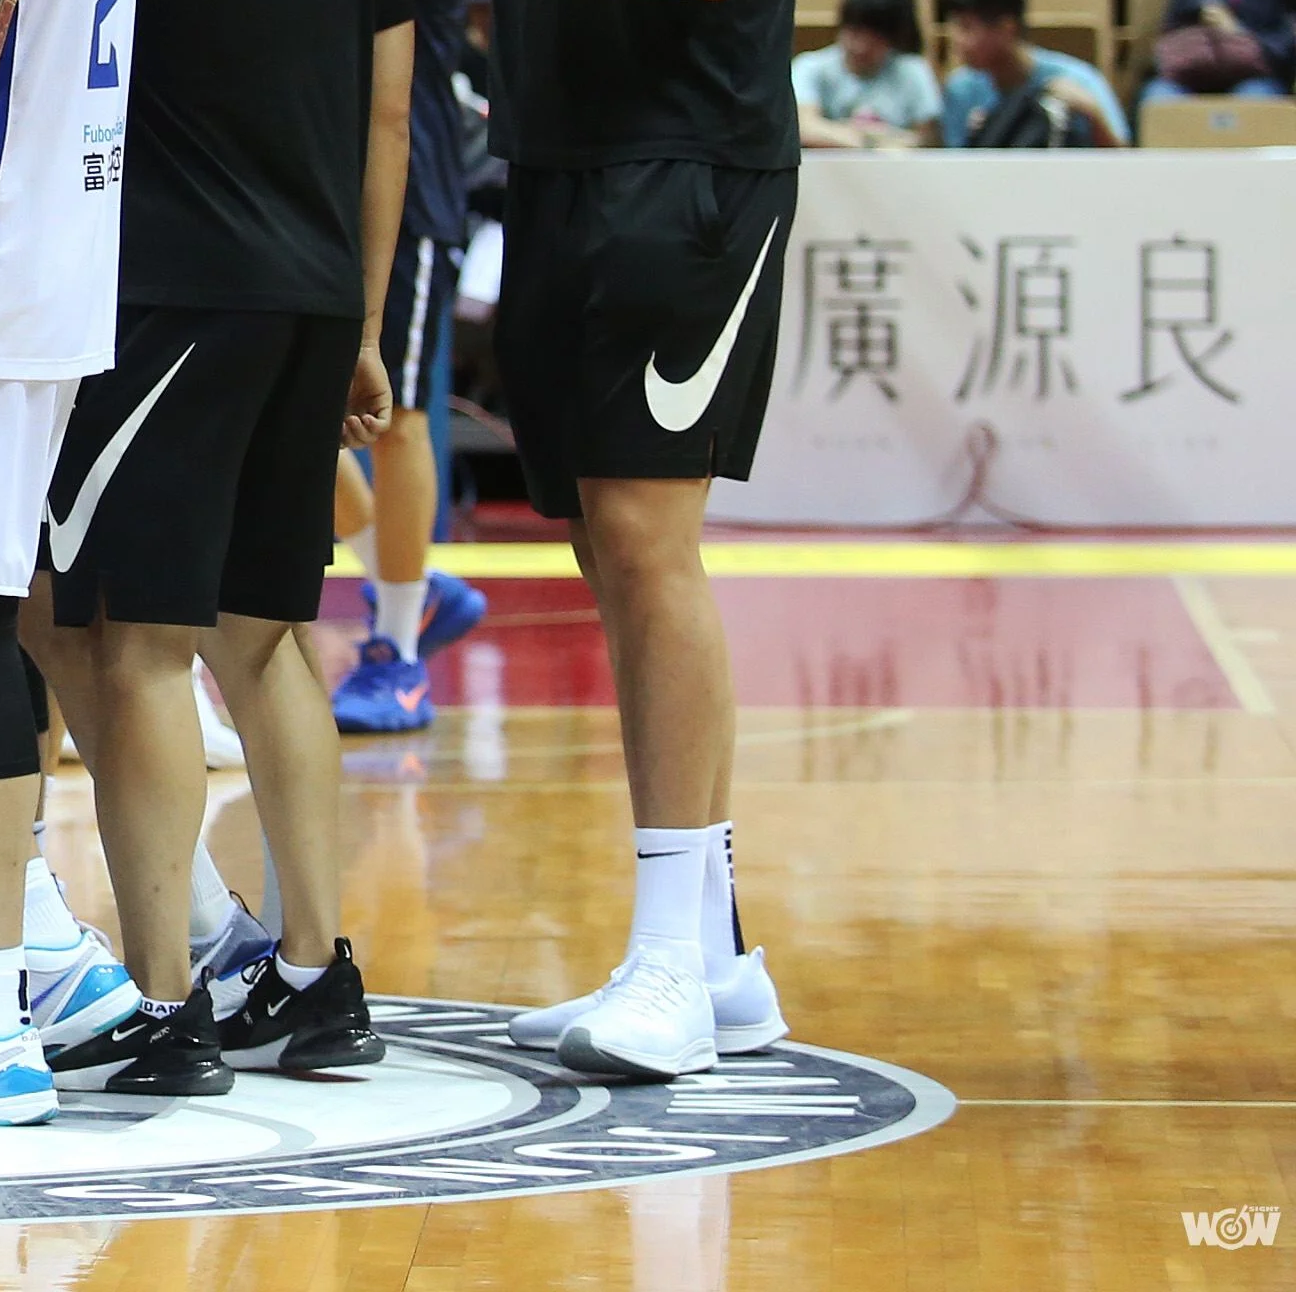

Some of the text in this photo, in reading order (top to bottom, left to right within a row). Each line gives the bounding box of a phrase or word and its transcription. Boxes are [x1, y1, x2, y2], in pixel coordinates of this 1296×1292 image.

[790, 231, 1242, 406] 廣源良
[36, 1126, 789, 1208] JONES
